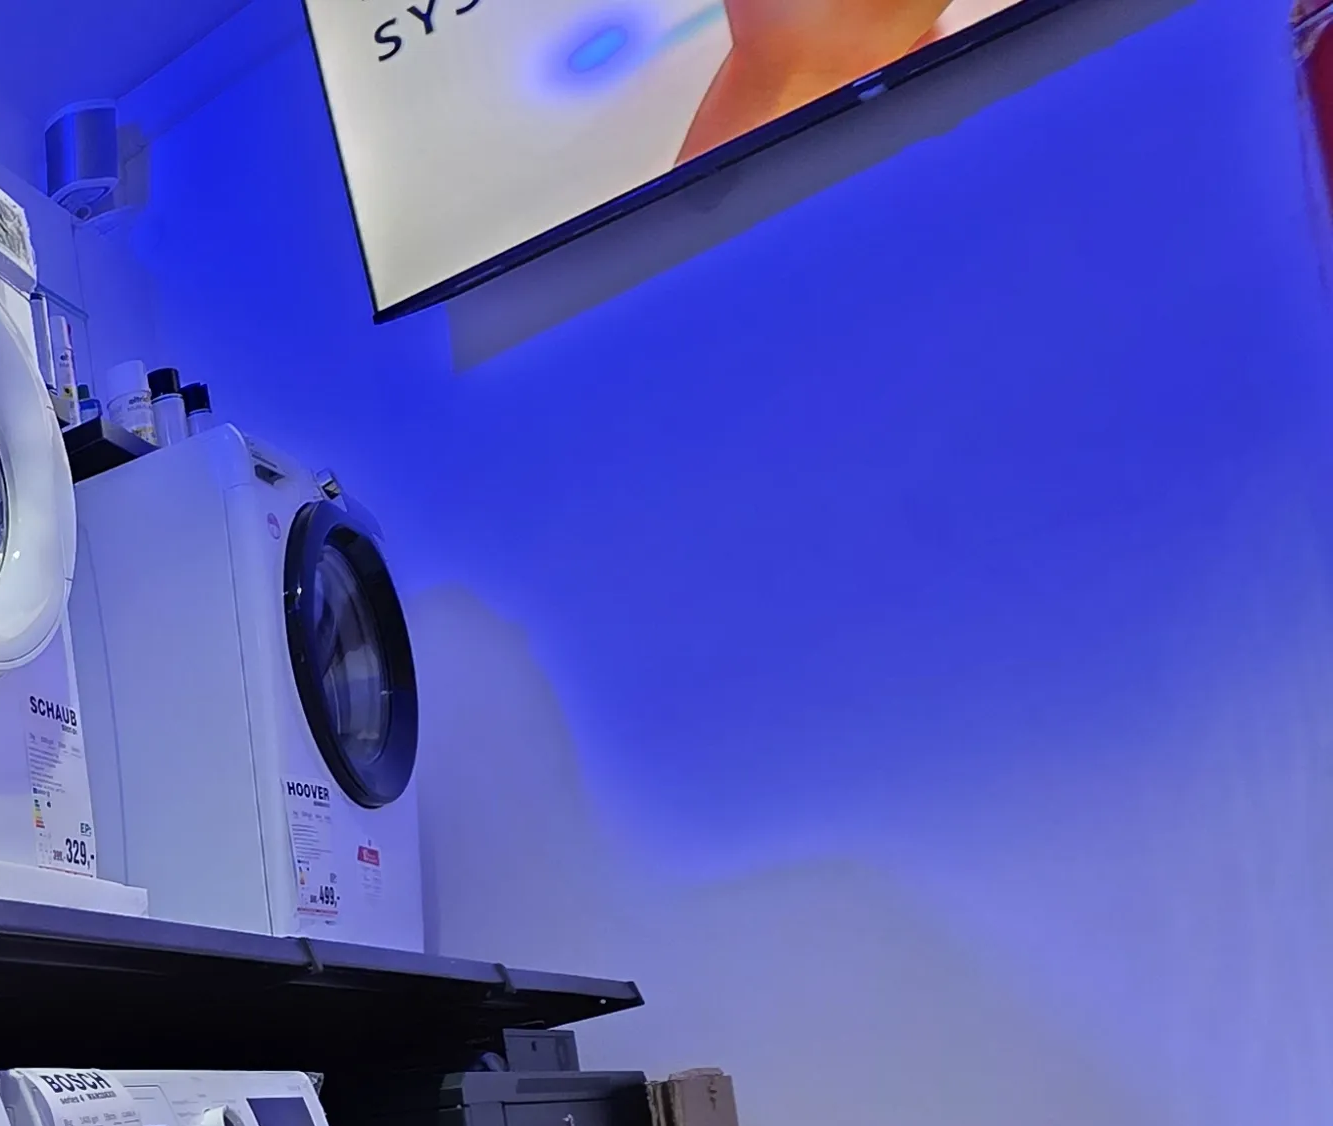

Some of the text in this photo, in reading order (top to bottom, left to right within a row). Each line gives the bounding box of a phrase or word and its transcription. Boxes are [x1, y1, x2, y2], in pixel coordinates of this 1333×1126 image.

[374, 0, 480, 62] SY
[29, 695, 78, 727] SCHAUB
[286, 781, 330, 801] HOOVER
[65, 838, 95, 870] 329,-
[39, 1071, 112, 1093] BOSCH
